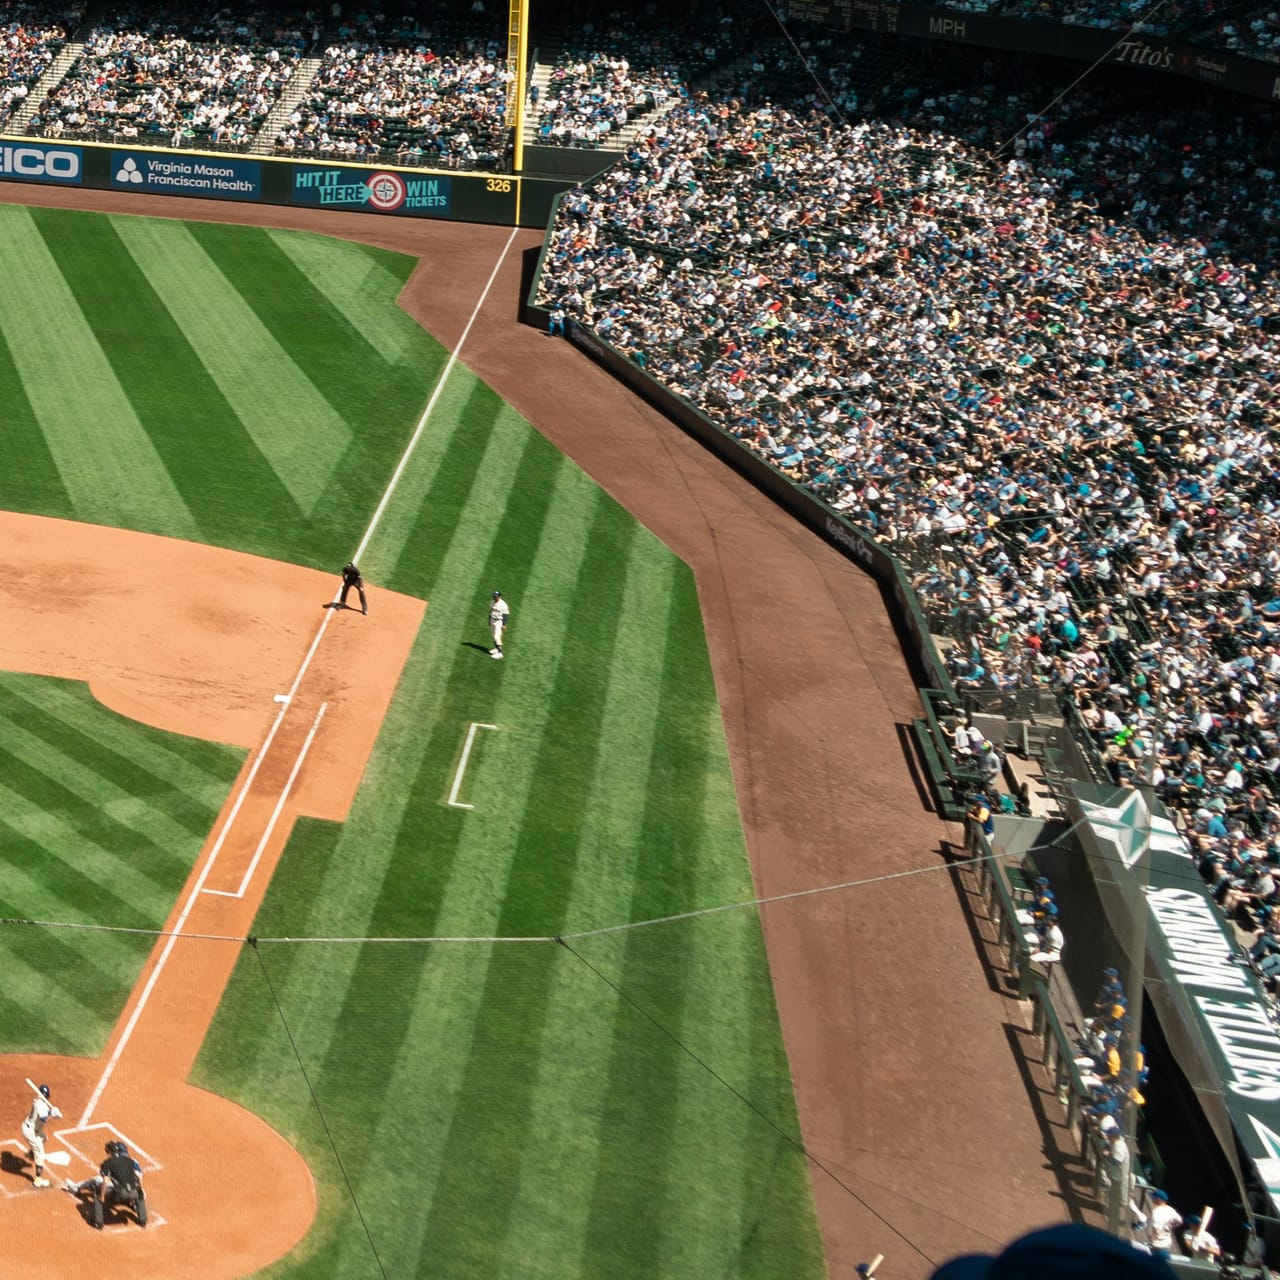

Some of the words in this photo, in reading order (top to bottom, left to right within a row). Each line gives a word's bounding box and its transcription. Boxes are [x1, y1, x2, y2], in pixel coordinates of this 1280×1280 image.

[929, 17, 966, 37] MPH
[1115, 40, 1175, 69] Tito's
[147, 160, 192, 176] Virginia
[194, 164, 234, 177] Mason
[147, 173, 211, 188] Franciscan
[213, 177, 253, 191] Health
[296, 172, 323, 188] HIT
[325, 171, 341, 186] IT
[486, 179, 511, 193] 326
[322, 186, 364, 202] HERE
[406, 180, 439, 197] WIN
[405, 196, 447, 208] TICKETS
